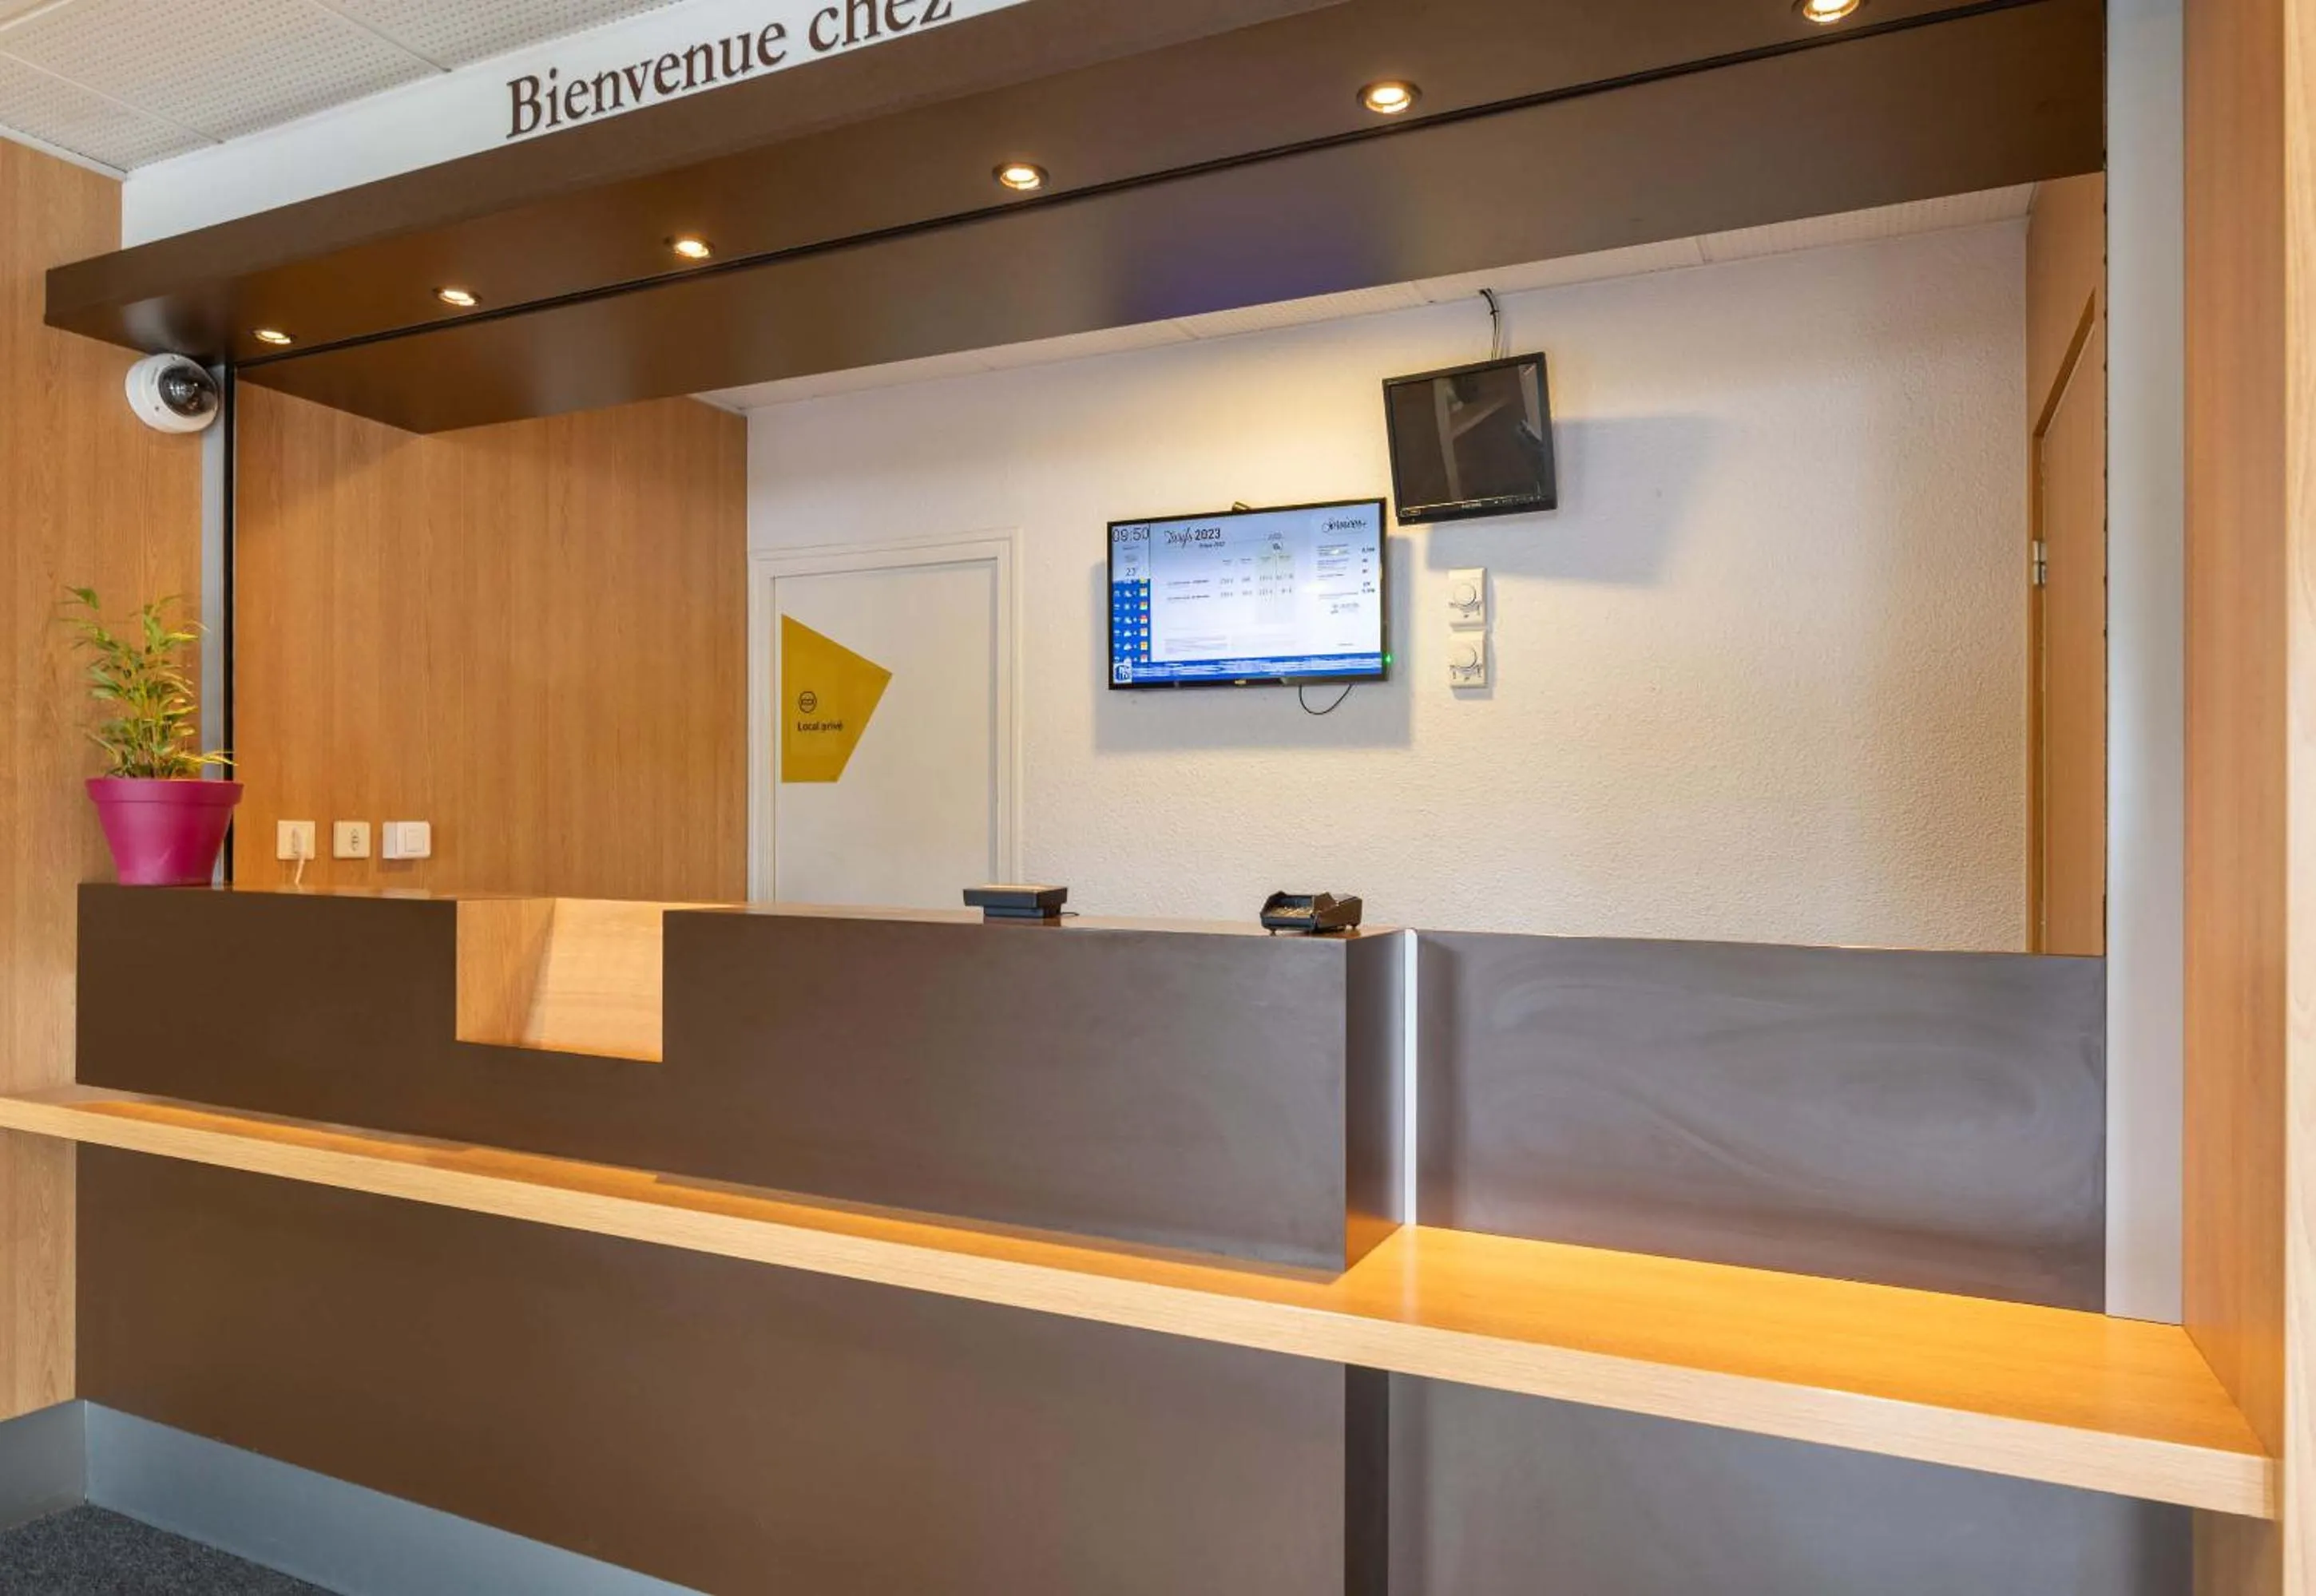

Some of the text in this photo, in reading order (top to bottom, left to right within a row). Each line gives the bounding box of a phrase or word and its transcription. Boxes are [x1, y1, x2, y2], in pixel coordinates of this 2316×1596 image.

[506, 22, 787, 139] Bienvenue
[1112, 527, 1149, 542] 09:50
[1194, 528, 1220, 541] 2023
[798, 721, 819, 731] Local
